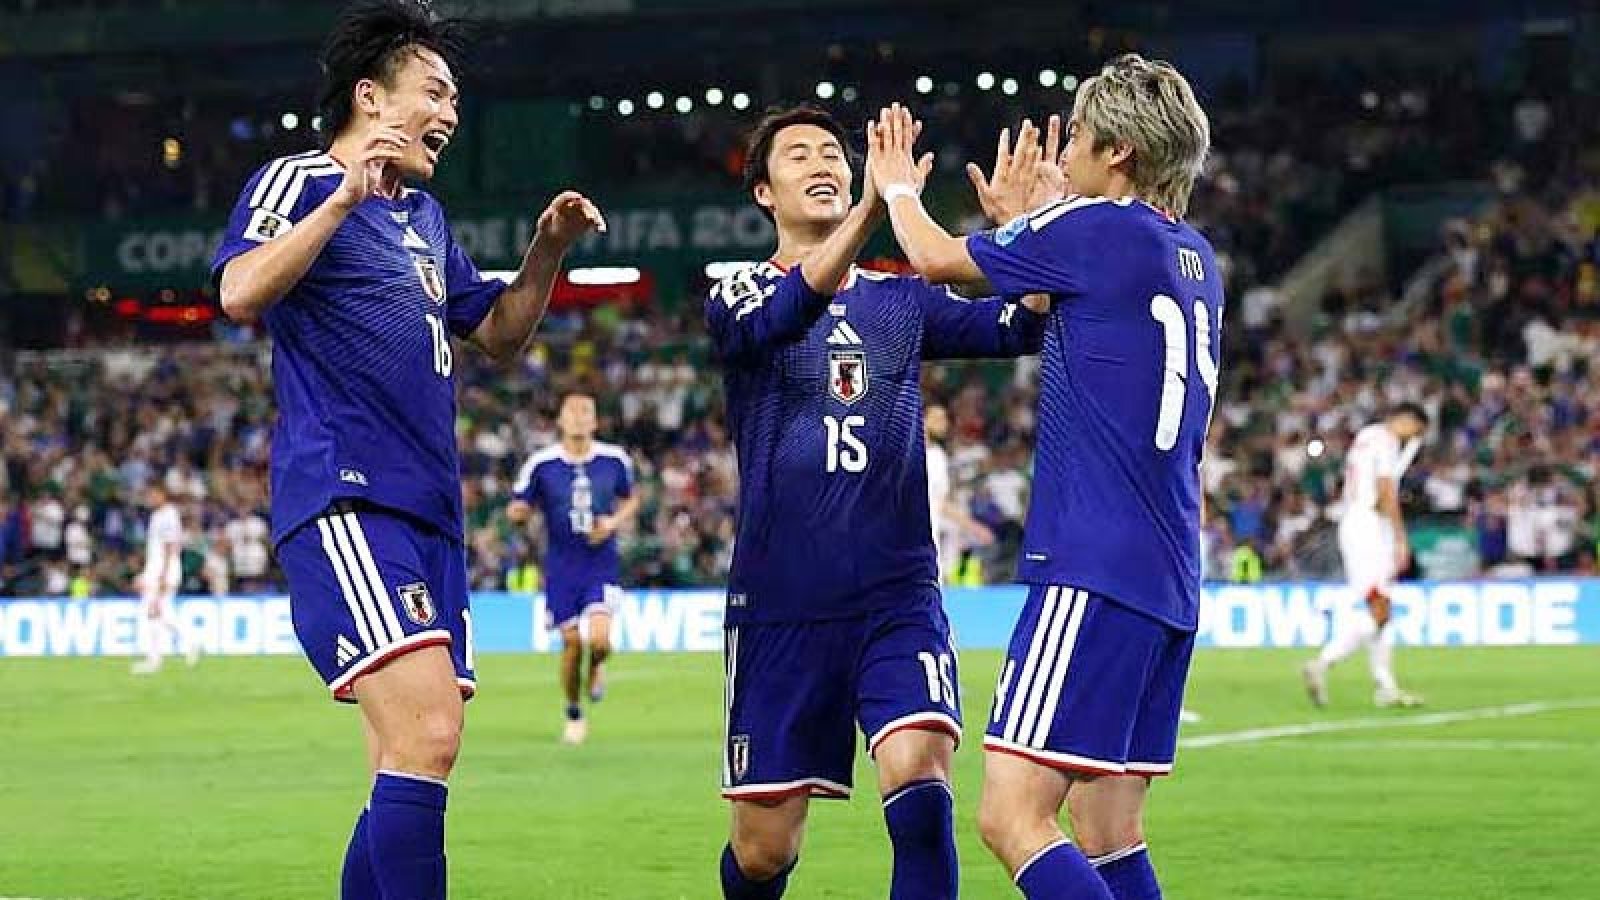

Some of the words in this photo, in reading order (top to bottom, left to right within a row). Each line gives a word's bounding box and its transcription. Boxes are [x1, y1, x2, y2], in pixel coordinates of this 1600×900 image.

[580, 209, 684, 254] IFA
[1177, 247, 1205, 281] ITO
[425, 312, 453, 378] 16
[1151, 293, 1224, 451] 14
[823, 414, 869, 474] 15
[917, 651, 956, 711] 15
